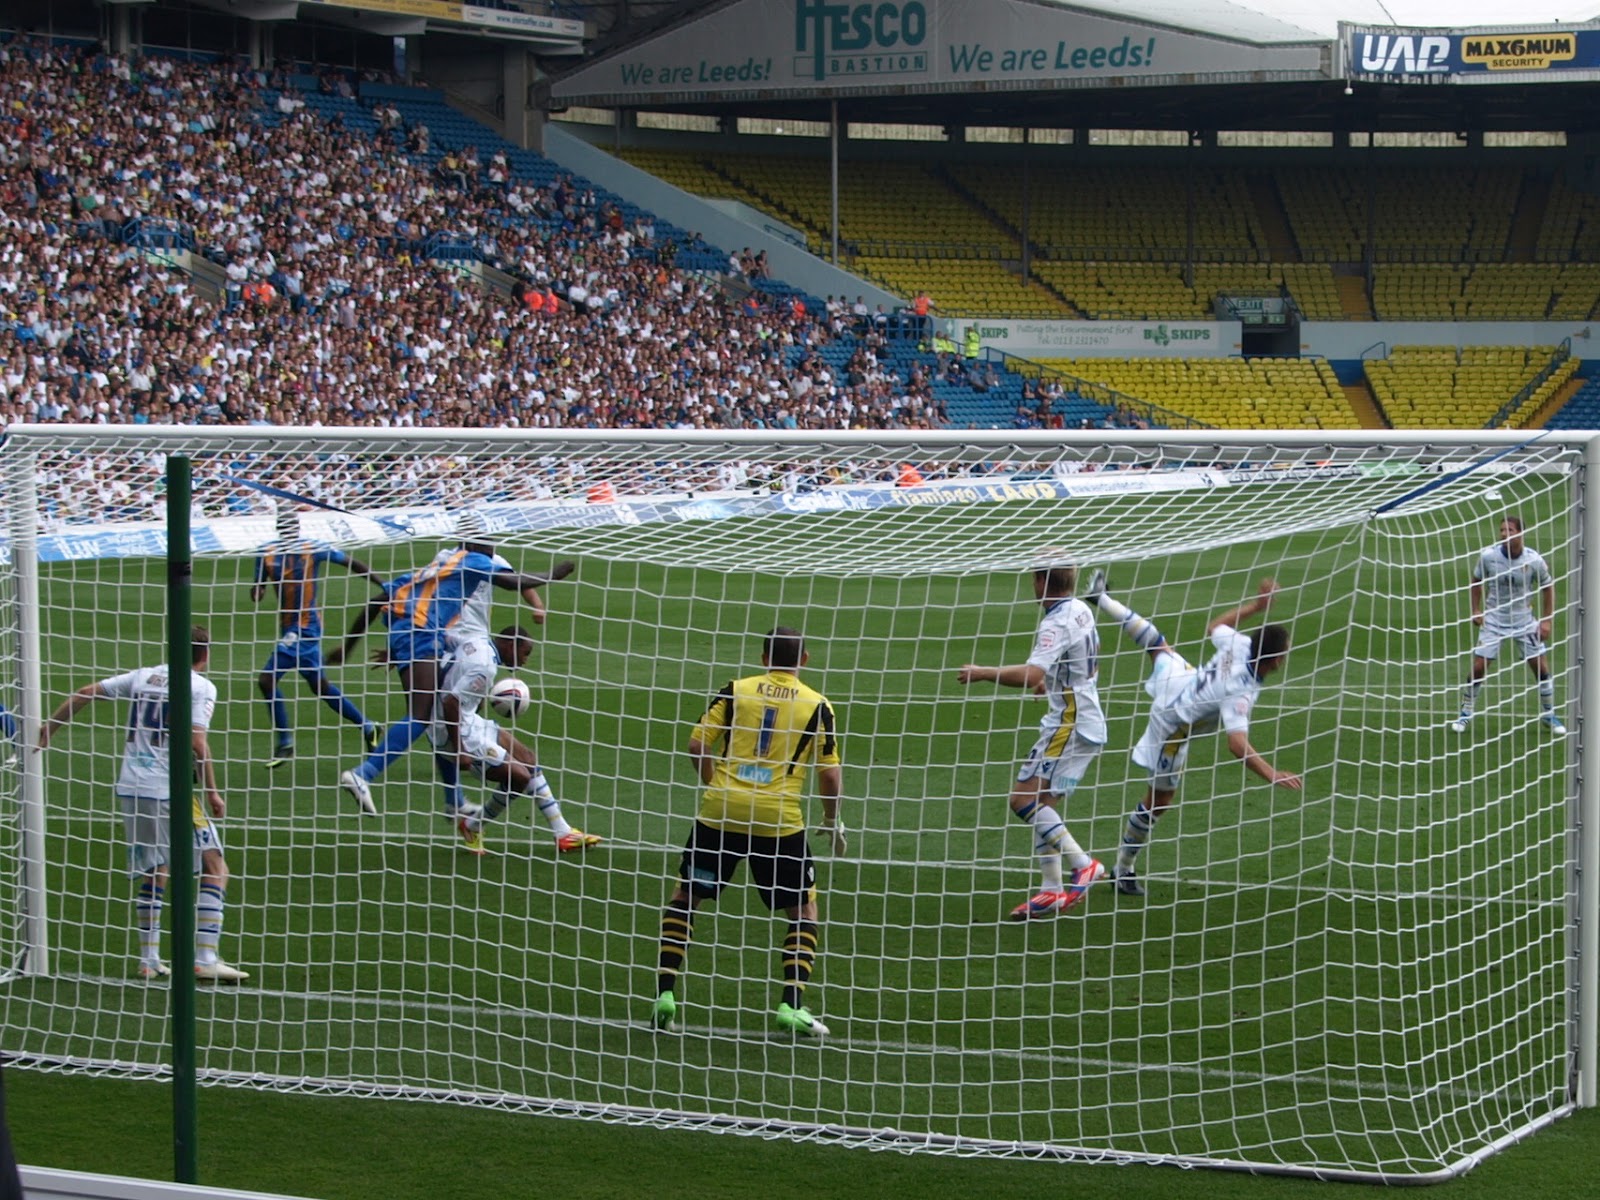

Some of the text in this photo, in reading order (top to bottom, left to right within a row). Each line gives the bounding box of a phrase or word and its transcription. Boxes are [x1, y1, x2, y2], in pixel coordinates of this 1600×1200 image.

[950, 37, 1156, 73] We are Leeds!
[1466, 38, 1571, 57] MAX6MUM
[620, 57, 772, 85] We are Leeds!
[831, 55, 924, 73] BASTION
[1492, 58, 1544, 68] SECURITY
[1238, 300, 1262, 309] EXIT
[981, 327, 1008, 339] SKIPS
[1172, 329, 1211, 340] SKIPS
[986, 482, 1057, 501] LAND
[757, 682, 799, 700] KENNY
[754, 706, 778, 757] 1
